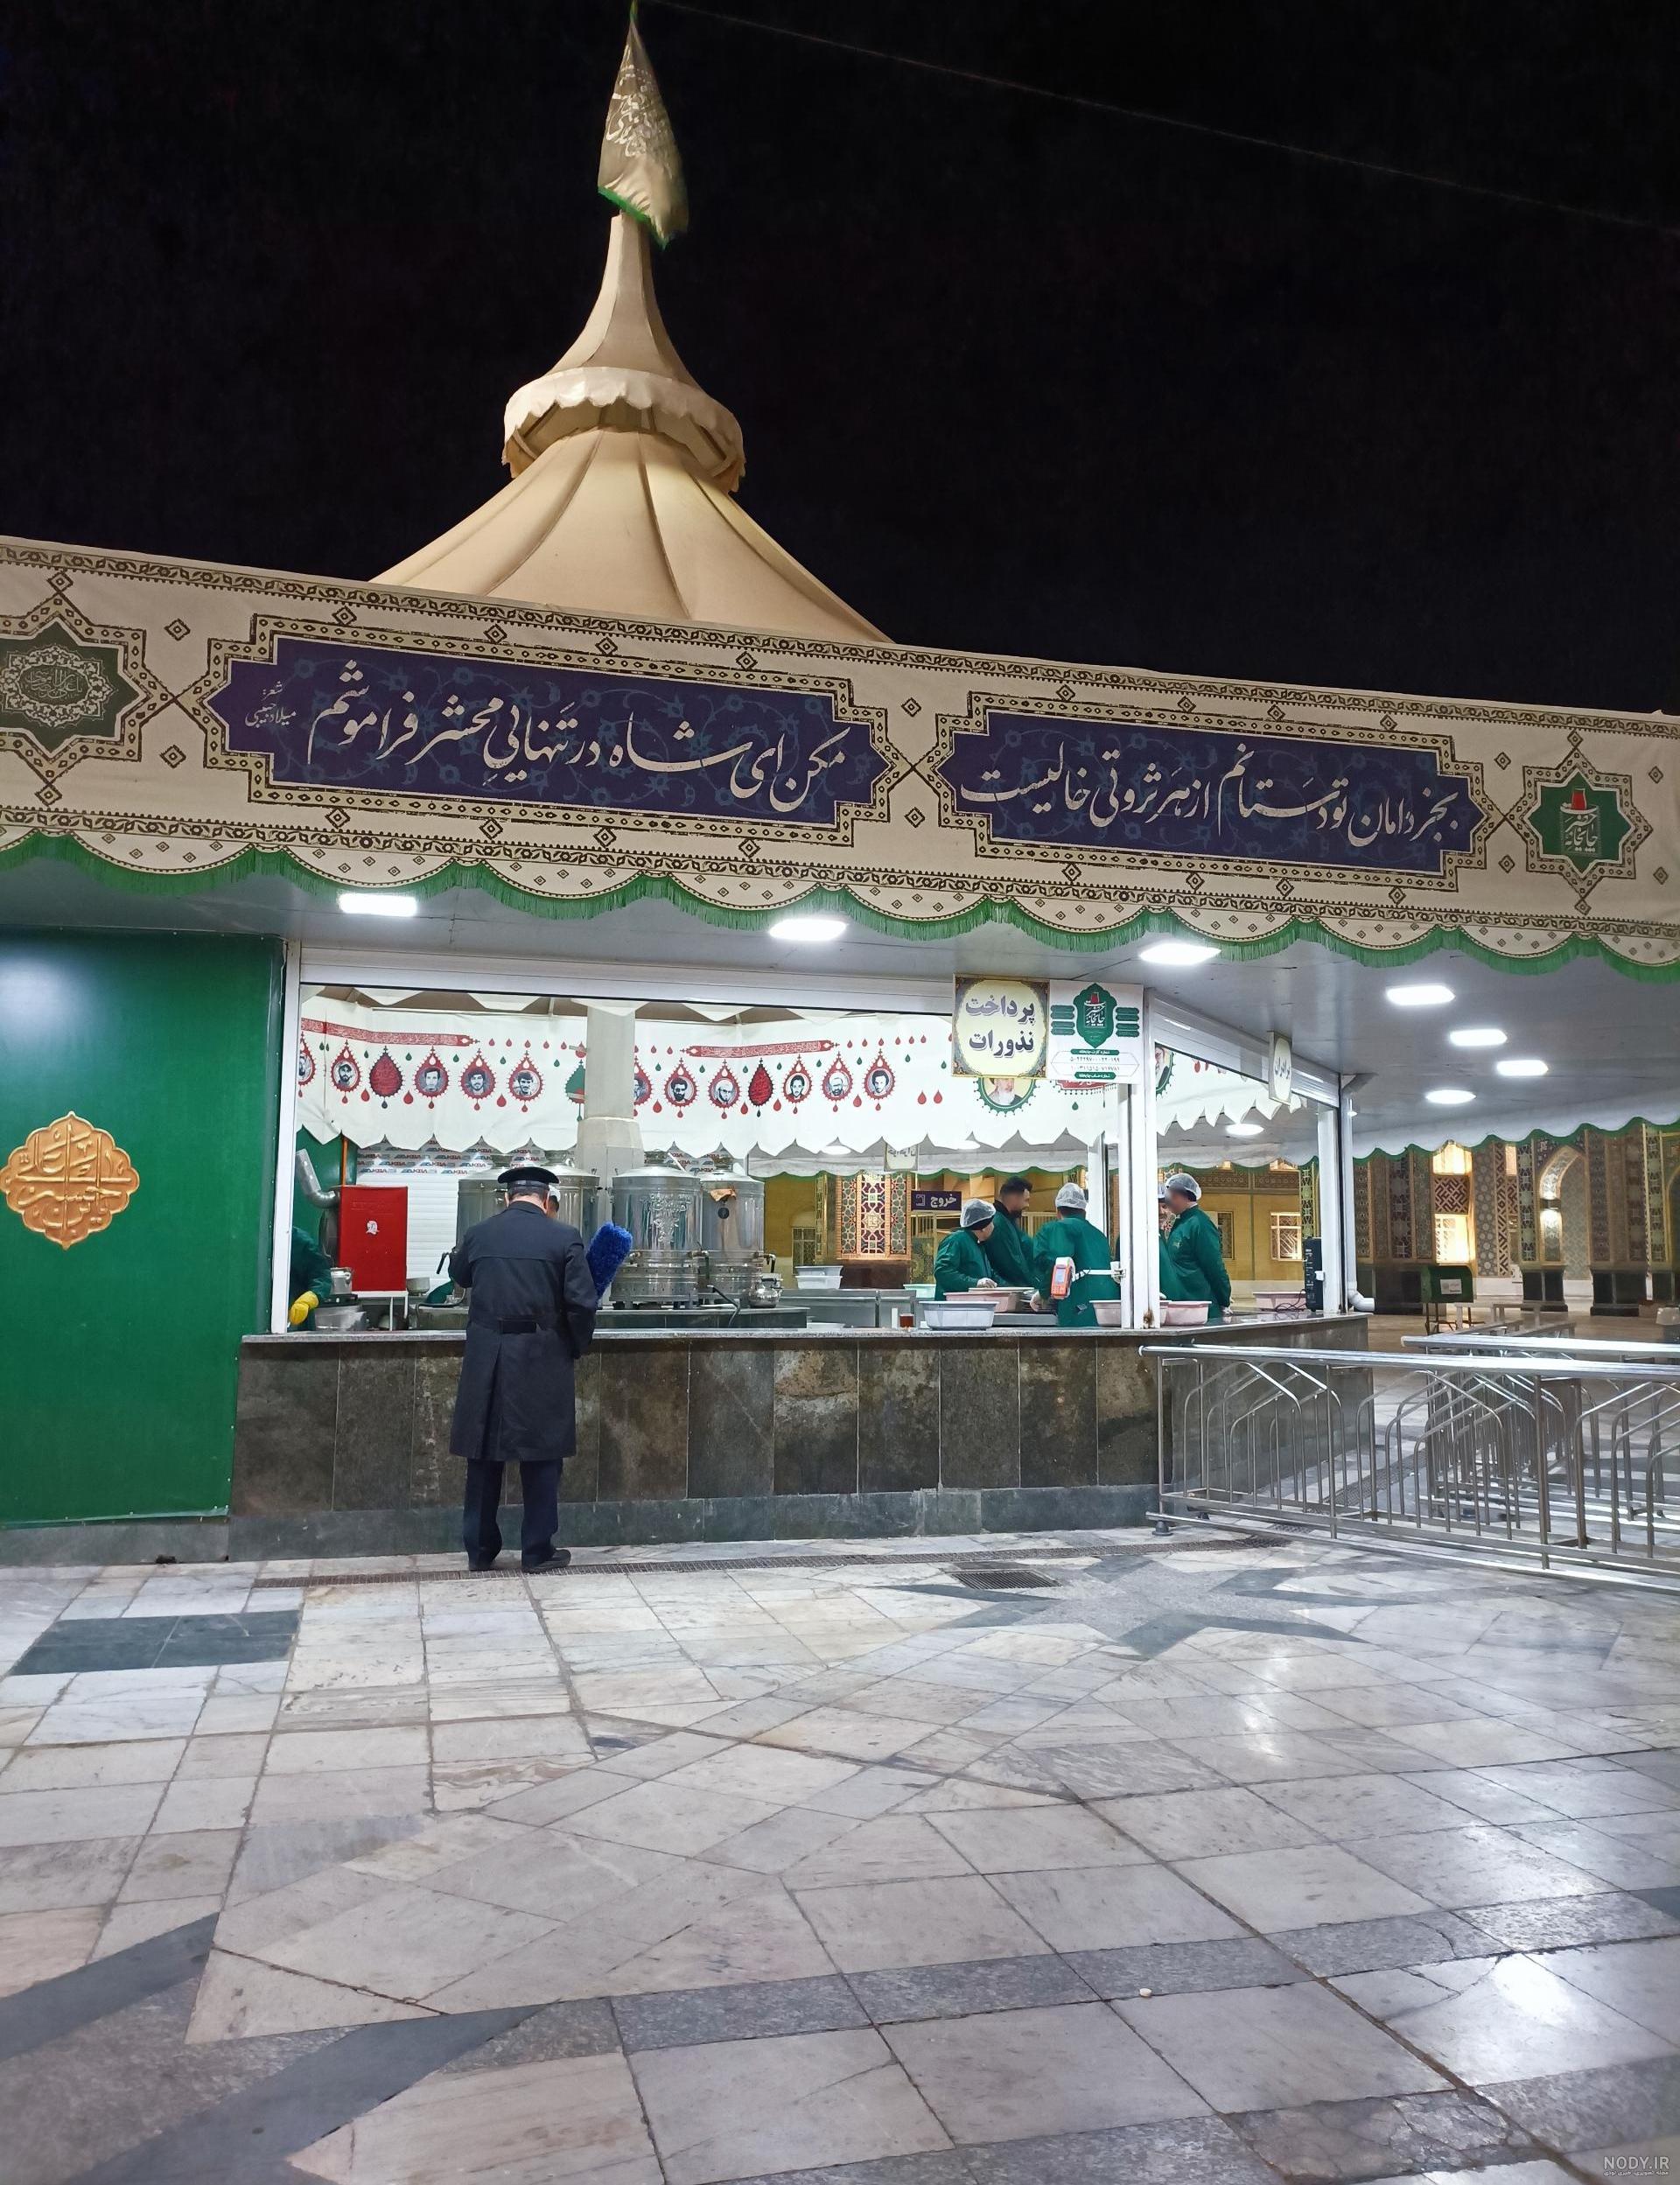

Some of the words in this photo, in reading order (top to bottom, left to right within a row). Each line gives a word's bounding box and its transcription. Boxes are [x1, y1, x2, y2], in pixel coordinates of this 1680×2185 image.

[307, 659, 419, 766] فراموشم
[404, 694, 505, 766] محشر
[566, 740, 601, 767] در
[609, 711, 753, 773] شاه
[730, 733, 786, 800] ای
[769, 726, 851, 813] مکن
[961, 741, 1092, 815] خالیست
[1089, 749, 1162, 828] ثروتی
[1144, 770, 1191, 824] هر
[1184, 780, 1211, 819] از
[1218, 743, 1340, 837] دستانم
[1329, 777, 1349, 830] تو
[1348, 796, 1415, 847] دامان
[1410, 788, 1459, 843] بجز
[965, 994, 1035, 1025] پرداخت
[969, 1030, 1034, 1058] نذورات
[930, 1193, 957, 1208] خروج
